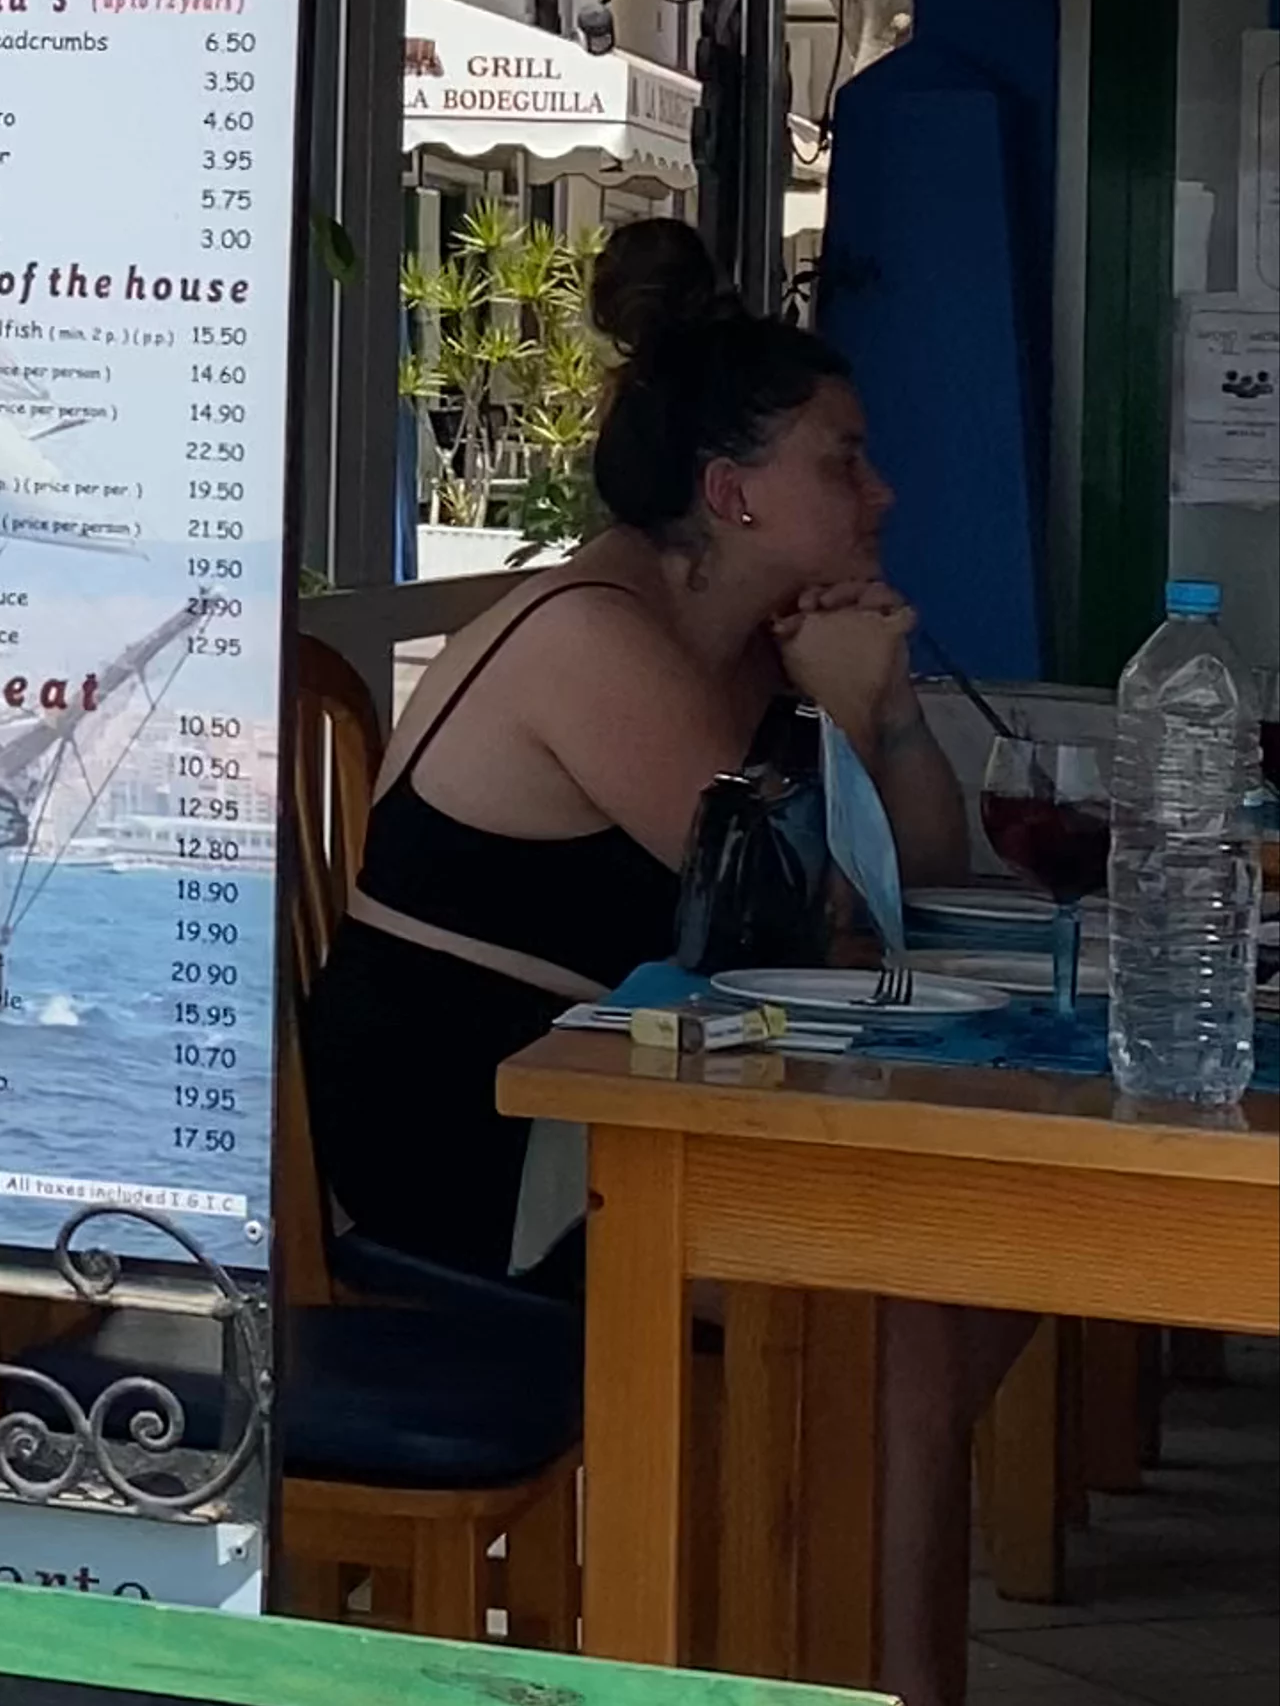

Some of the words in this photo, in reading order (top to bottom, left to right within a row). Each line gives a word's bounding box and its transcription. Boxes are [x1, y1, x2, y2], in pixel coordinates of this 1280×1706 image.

[467, 55, 562, 80] GRILL
[204, 72, 255, 93] 3.50
[403, 89, 429, 109] A
[443, 89, 605, 114] BODEGUILLA
[200, 189, 252, 211] 5.75
[48, 261, 113, 301] the
[124, 265, 249, 305] house
